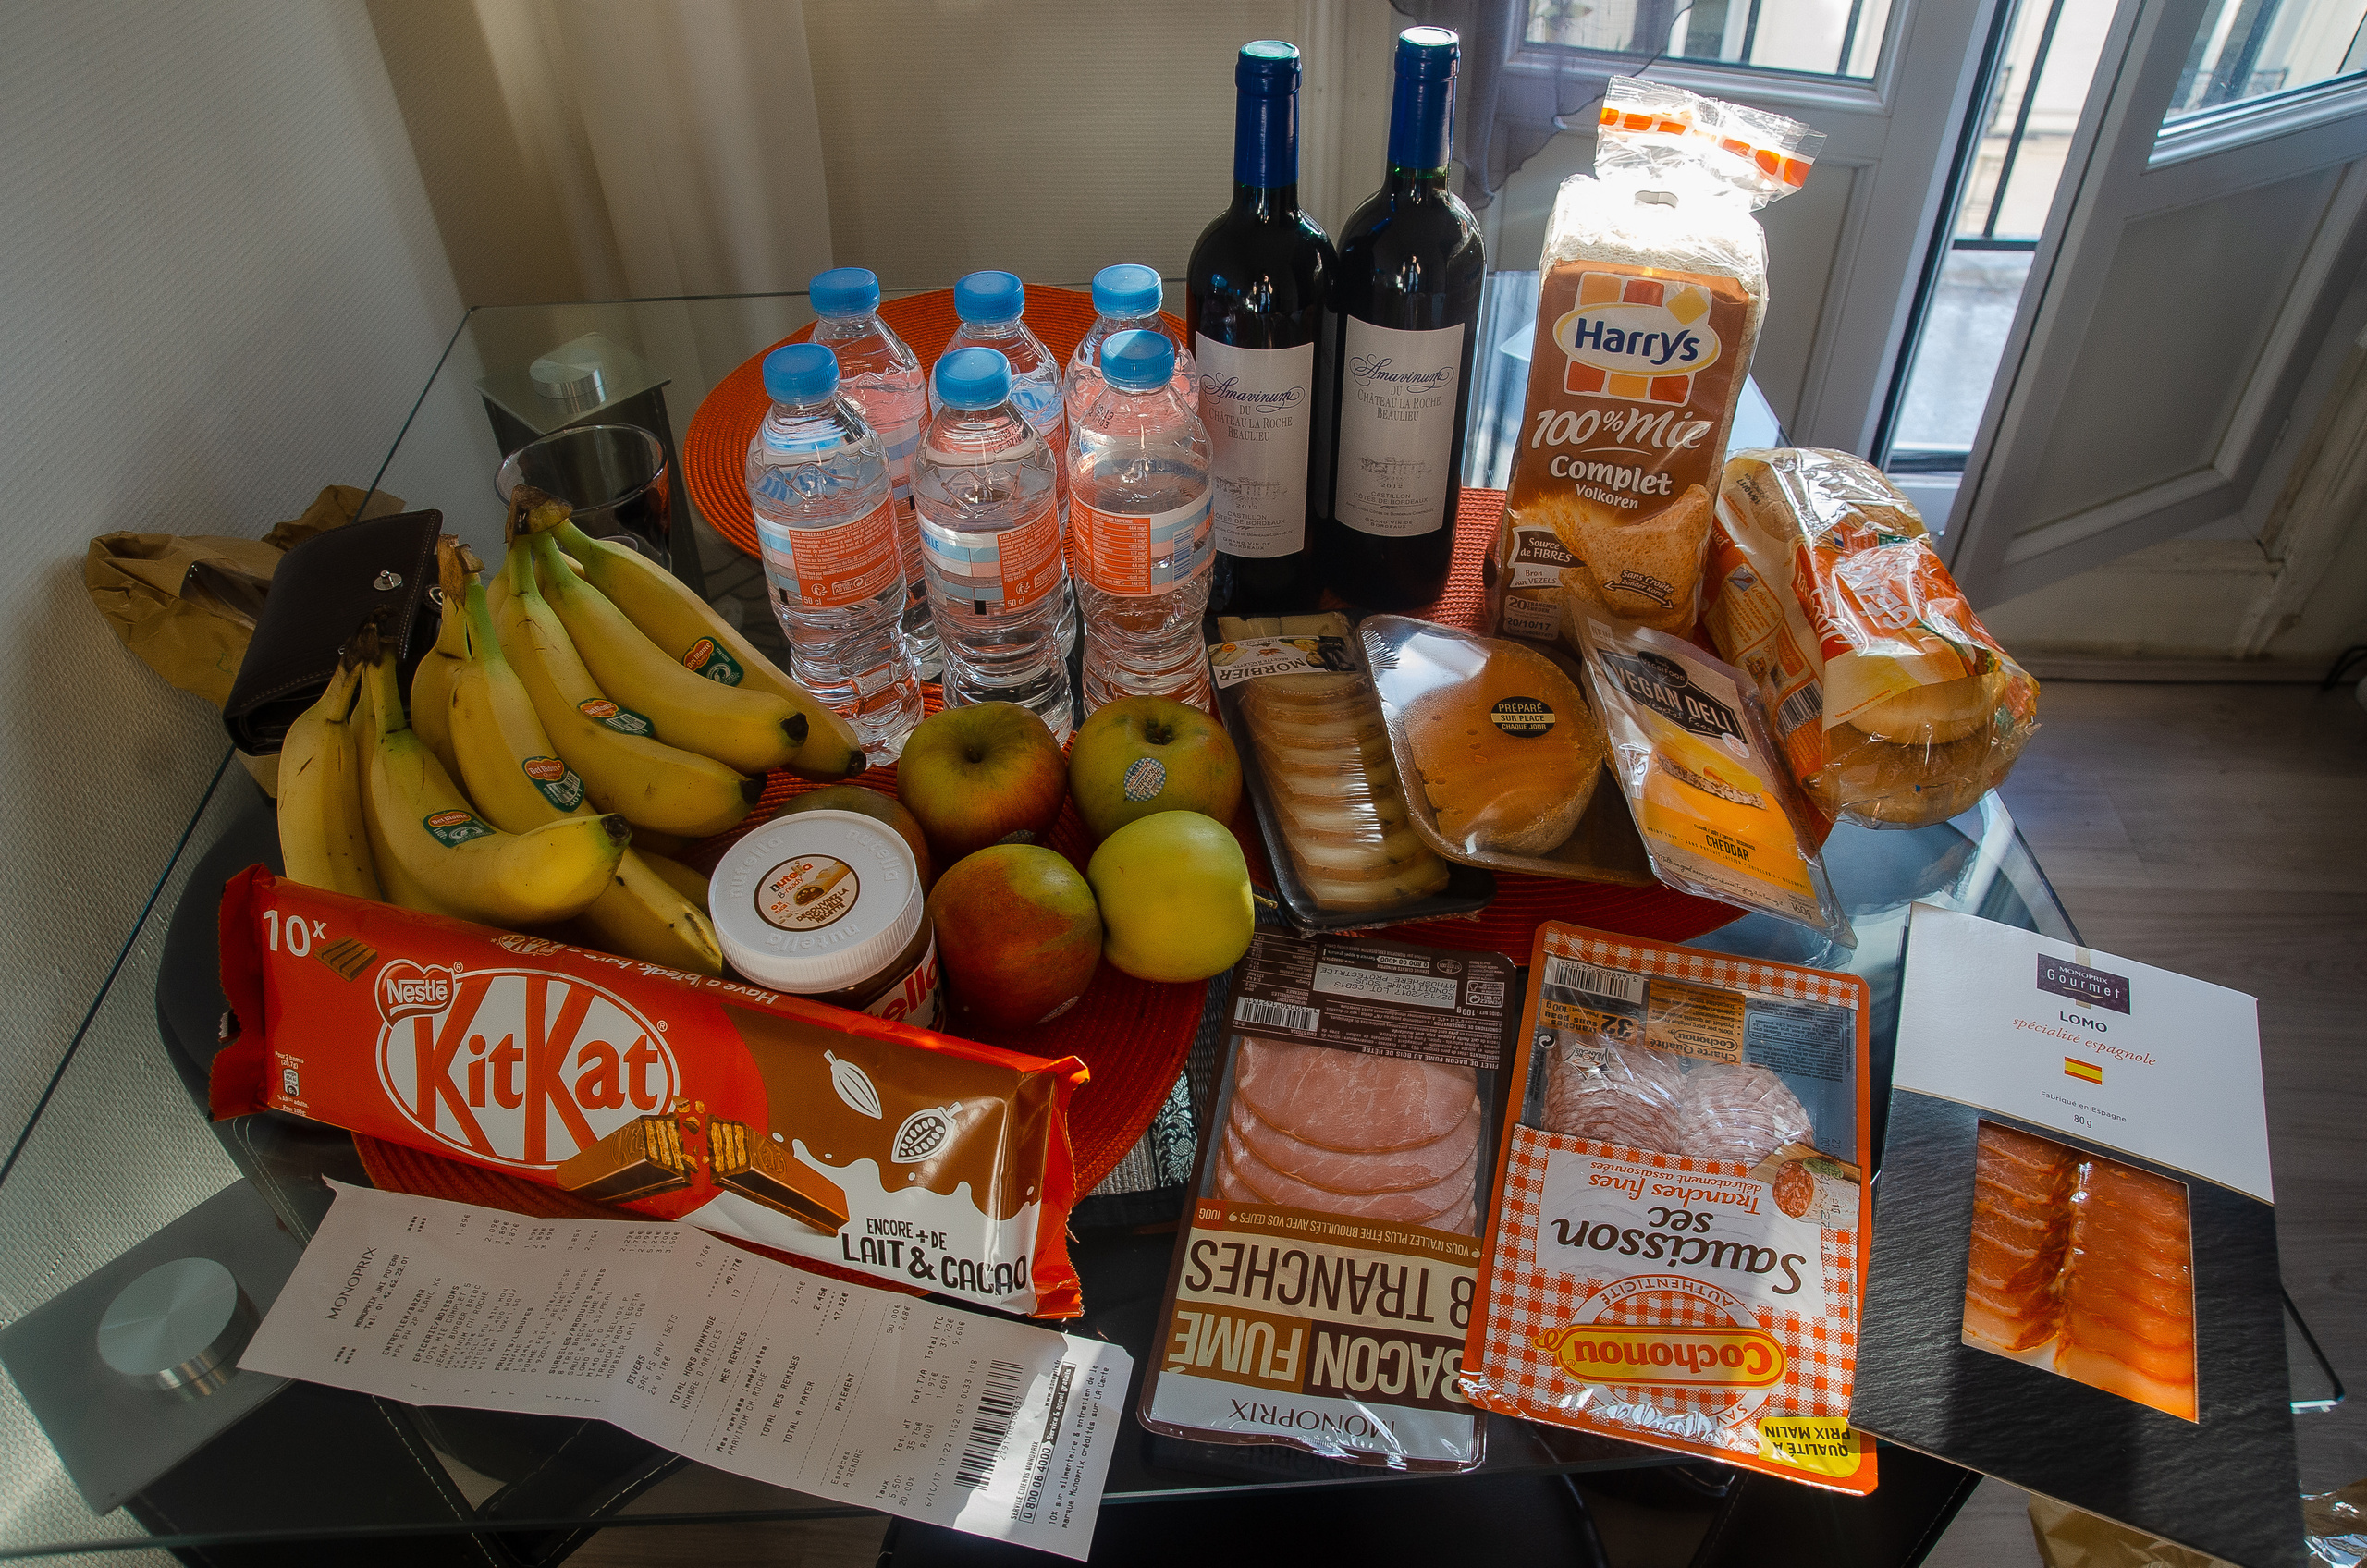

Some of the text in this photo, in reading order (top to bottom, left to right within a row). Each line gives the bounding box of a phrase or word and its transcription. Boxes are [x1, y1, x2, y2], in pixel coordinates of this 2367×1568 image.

[1575, 317, 1700, 365] Harrys
[1349, 354, 1454, 393] Amavinum
[1200, 372, 1306, 413] Amavinum
[1391, 386, 1403, 396] DU
[1399, 399, 1411, 409] LA
[1413, 396, 1441, 408] ROCHE
[1239, 405, 1250, 415] DU
[1249, 419, 1260, 428] LA
[1263, 416, 1293, 428] ROCHE
[1377, 408, 1419, 421] BEAULIEU
[1228, 425, 1270, 441] BEAULIEU
[1531, 408, 1714, 449] 100% Mie
[1551, 455, 1673, 496] Complet
[1371, 491, 1411, 499] CASTILLON
[1576, 484, 1638, 508] Volkoren
[1528, 537, 1560, 549] Source
[1520, 548, 1572, 563] de FIBRES
[1621, 579, 1665, 597] Zonder Korst
[1622, 570, 1674, 594] Sans Croûte
[804, 596, 812, 605] 50
[1508, 597, 1526, 609] 20
[1507, 617, 1551, 631] 20/10/17
[1220, 657, 1306, 680] MORBIER
[1499, 703, 1542, 712] PRÉPARÉ
[1611, 662, 1733, 732] VEGAN DELI
[528, 766, 541, 776] Del
[1706, 835, 1750, 862] CHEDDAR
[769, 861, 814, 892] nutella
[778, 876, 804, 899] B-ready
[838, 888, 849, 897] LA
[807, 897, 844, 921] NOUVELLE
[816, 903, 846, 923] RECETTE
[2047, 969, 2120, 998] Gourmet
[2059, 966, 2107, 984] MONOPRIX
[386, 978, 448, 1004] Nestlé
[723, 983, 779, 1004] Have
[1393, 987, 1453, 999] 02/12/2017
[2059, 1011, 2107, 1033] LOMO
[2012, 1018, 2156, 1066] spécialité espagnole
[2041, 1091, 2077, 1107] Fabriqué
[2091, 1107, 2126, 1122] Espagne
[1590, 1161, 1761, 1194] délicatement assaisonnées
[1588, 1173, 1760, 1216] Tranches fines
[1198, 1207, 1221, 1220] 100G
[1268, 1215, 1285, 1227] VOS
[1286, 1217, 1308, 1230] AVEC
[1647, 1207, 1714, 1234] sec
[866, 1218, 914, 1239] ENCORE
[931, 1231, 947, 1250] DE
[1309, 1220, 1359, 1238] BROUILLÉS
[1361, 1227, 1383, 1243] ÊTRE
[1385, 1231, 1407, 1244] PLUS
[1409, 1234, 1444, 1254] N'ALLEZ
[1446, 1242, 1469, 1257] VOUS
[841, 1232, 1027, 1295] LAIT & CACAO
[1551, 1218, 1807, 1295] Saucisson
[326, 1243, 377, 1322] MONOPRIX
[355, 1253, 399, 1328] MONOPRIX UNI POTEAU
[365, 1256, 410, 1329] Tel: 01.42.62.22.01
[1185, 1239, 1477, 1329] 8 TRANCHES
[1600, 1277, 1734, 1307] AUTHENTICITÉ
[670, 1257, 741, 1404] TOTAL HORS AVANTAGE 49,77€
[761, 1286, 827, 1438] TOTAL DES REMISES 2,45€
[784, 1418, 797, 1444] TOTAL
[800, 1379, 813, 1405] PAYER
[833, 1292, 848, 1321] 47,32€
[1167, 1310, 1465, 1404] BACON FUMÉ
[1574, 1339, 1772, 1377] Cochonou
[835, 1372, 854, 1411] PAIEMENT
[1000, 1395, 1021, 1460] 2791700300337
[1228, 1398, 1395, 1441] MONOPRIX
[925, 1358, 976, 1507] 6/10/17 17:22 1162 03 0033 108
[1059, 1440, 1077, 1488] alimentaire
[1075, 1388, 1091, 1427] entretien
[1087, 1376, 1093, 1384] de
[1765, 1425, 1851, 1439] PRIX MALIN
[1062, 1500, 1073, 1528] marque
[1070, 1459, 1084, 1496] Monoprix
[1080, 1420, 1094, 1455] crédités
[1096, 1390, 1100, 1399] LA
[1098, 1366, 1107, 1387] Carte
[1787, 1442, 1849, 1458] QUALITÉ
[1026, 1489, 1036, 1509] 800
[1033, 1474, 1041, 1487] 08
[1037, 1446, 1049, 1472] 4000
